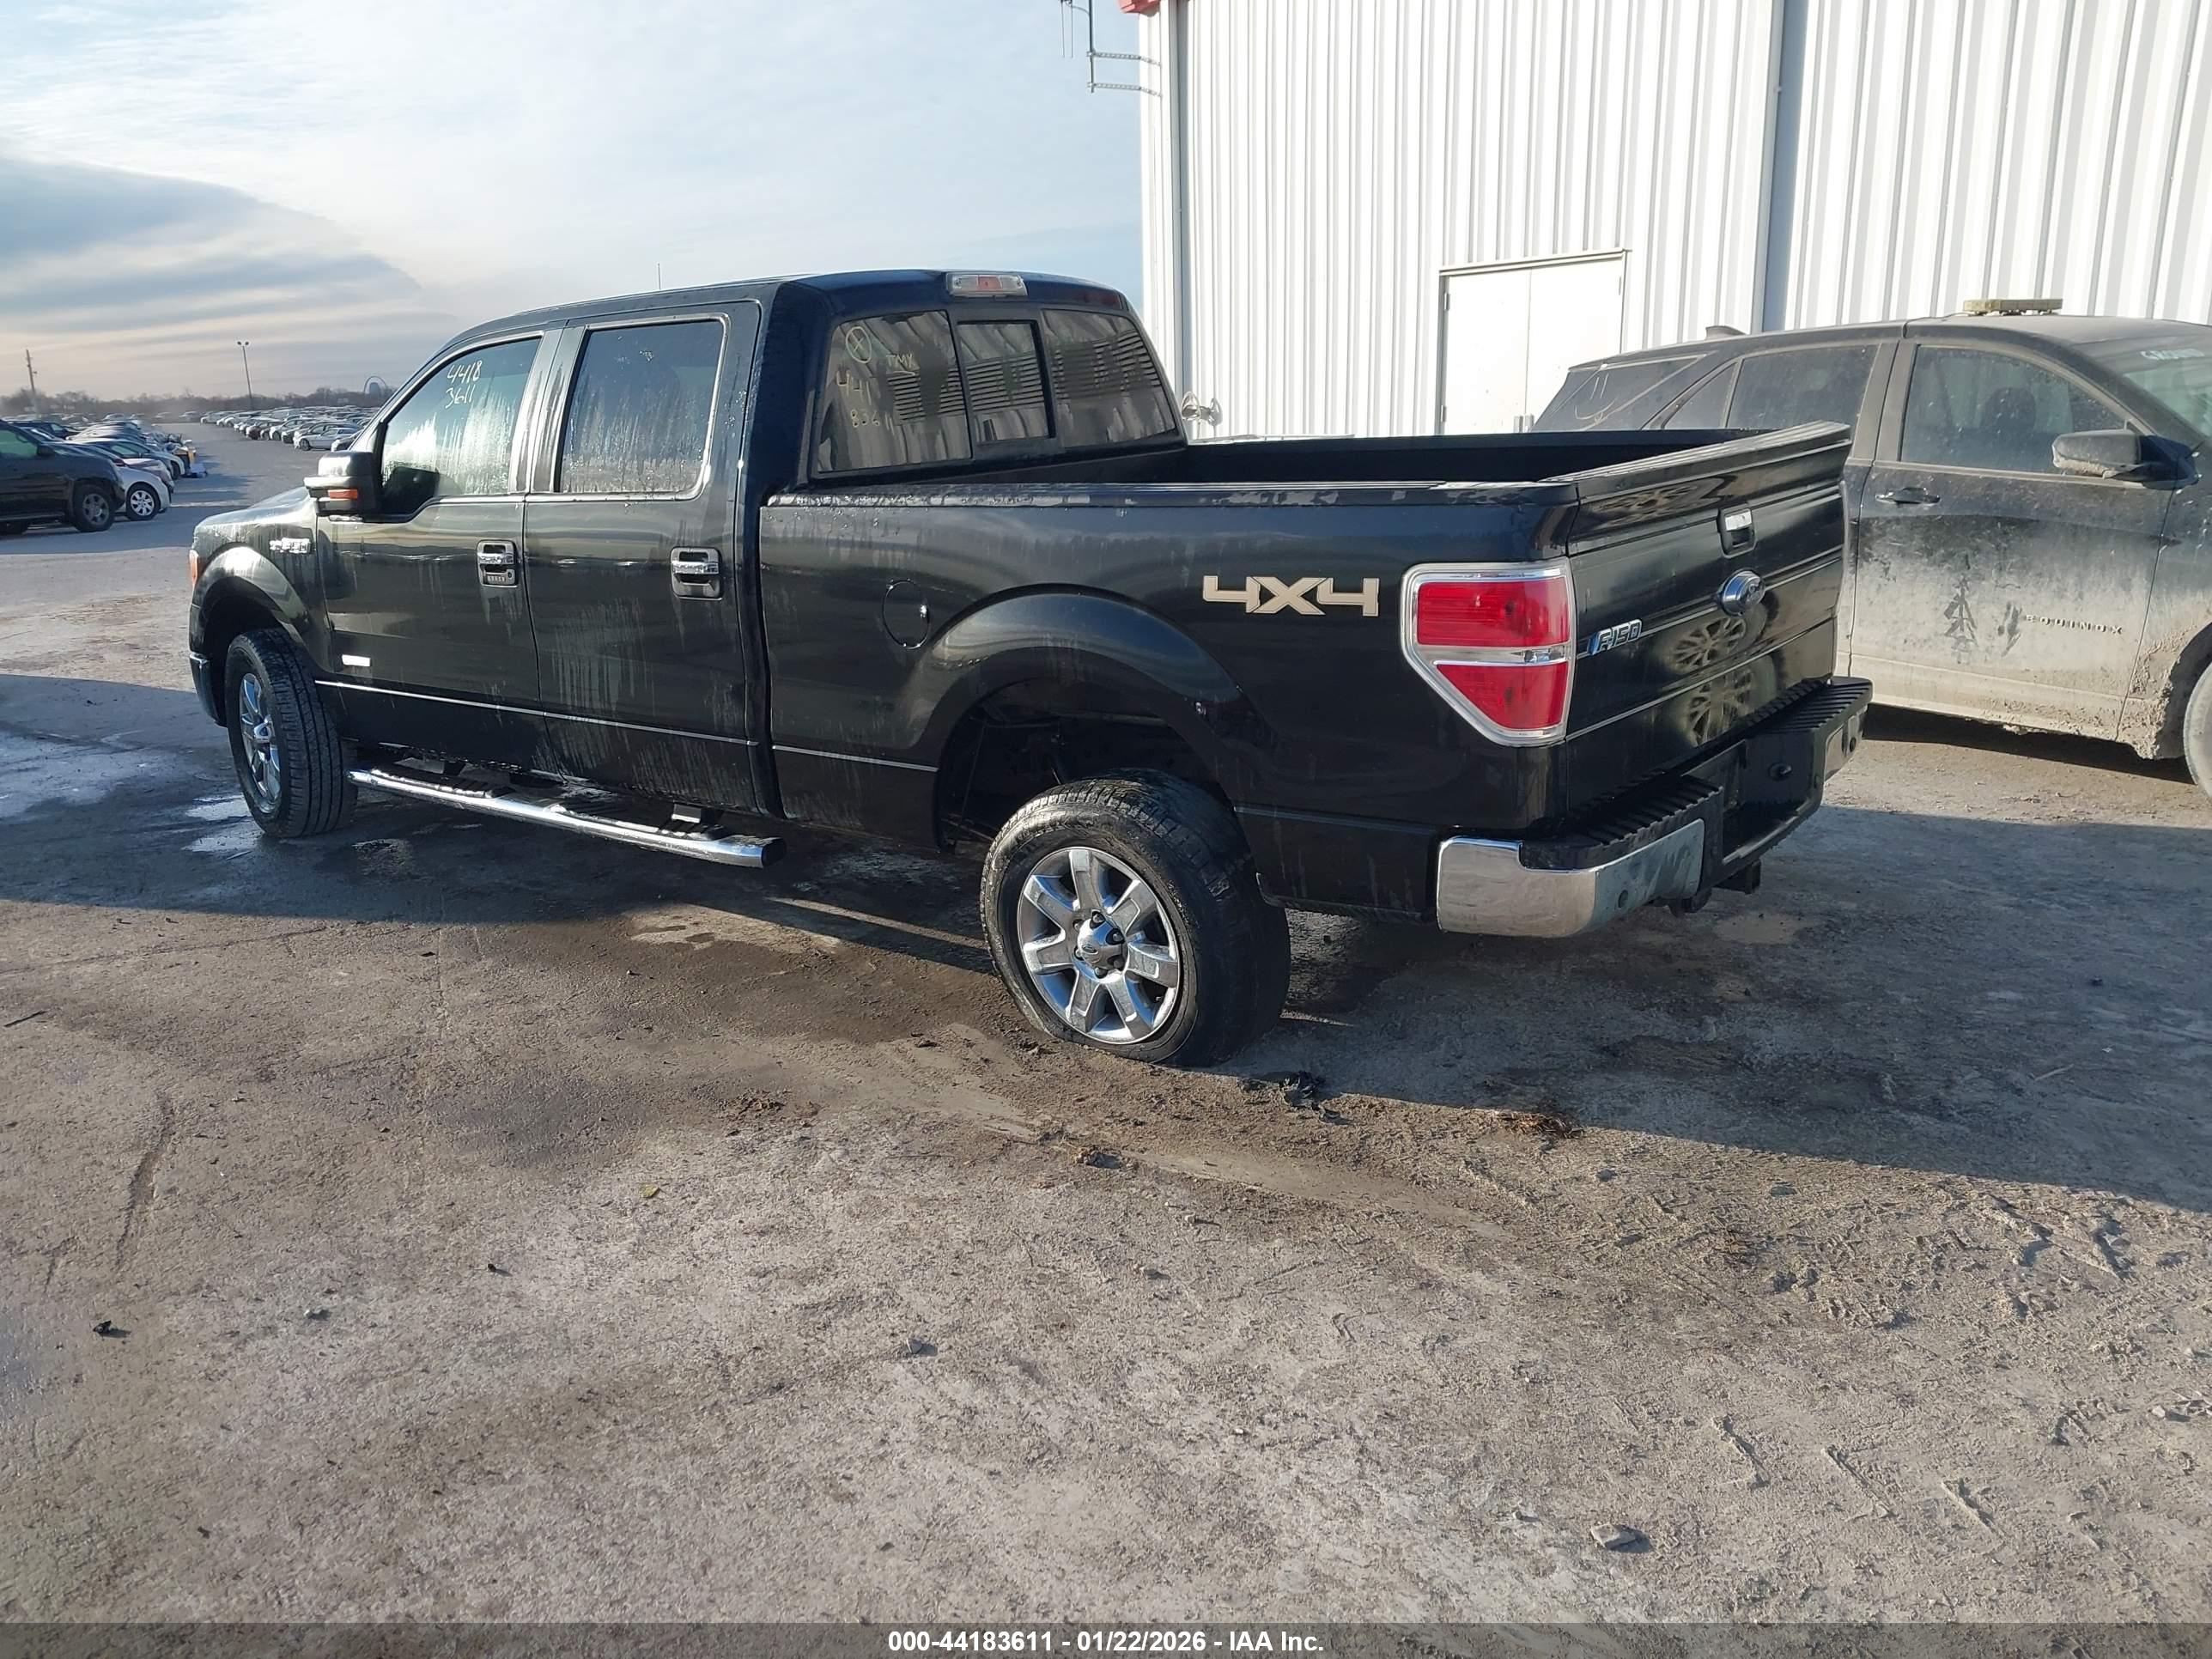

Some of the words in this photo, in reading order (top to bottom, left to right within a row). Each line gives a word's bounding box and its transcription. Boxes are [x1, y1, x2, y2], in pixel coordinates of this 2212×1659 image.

[447, 360, 483, 384] 4418
[445, 384, 477, 410] 3611
[1203, 575, 1380, 617] 4X4
[2025, 614, 2123, 635] EQUINOX
